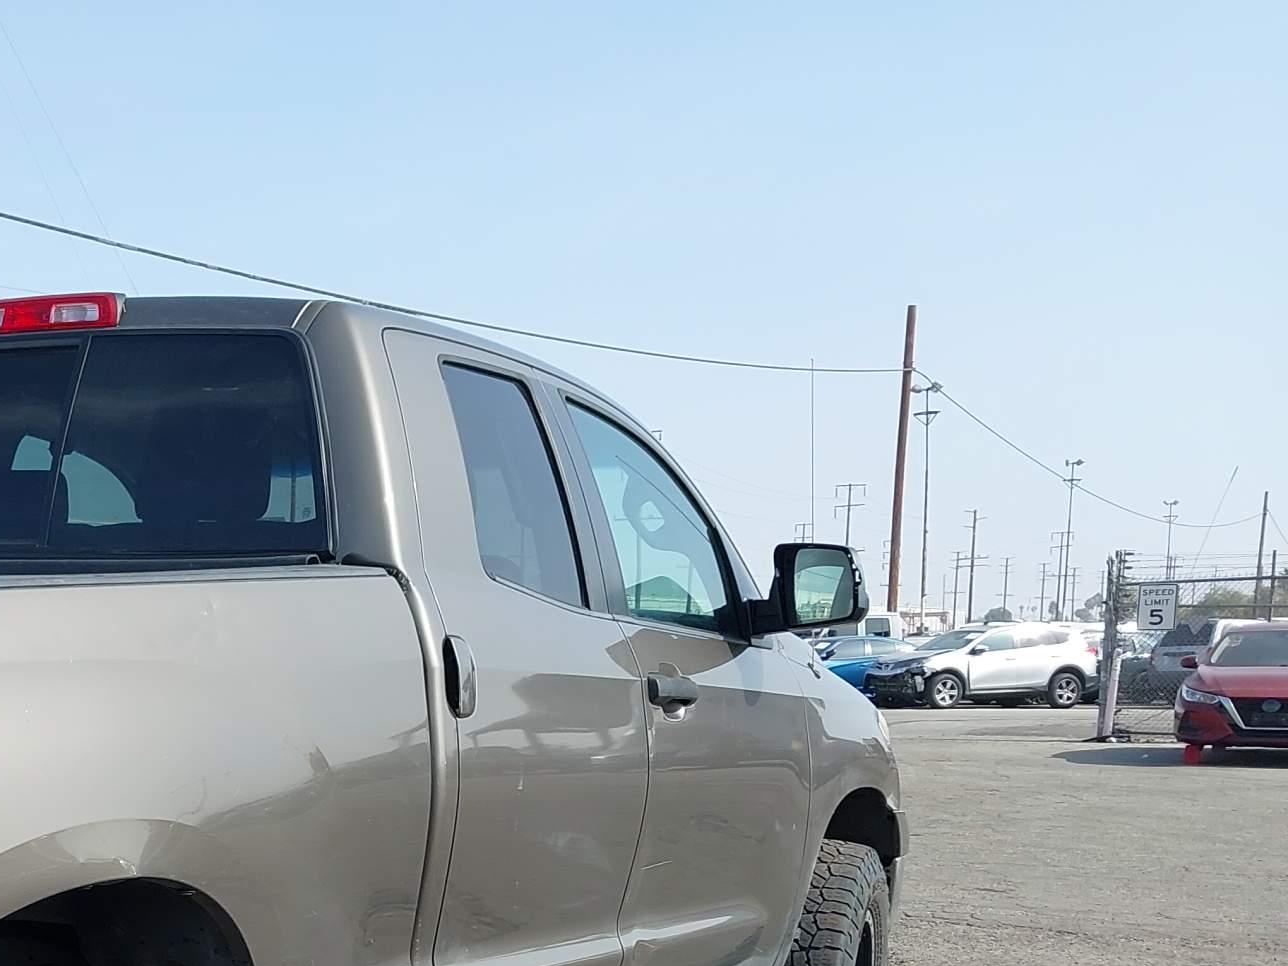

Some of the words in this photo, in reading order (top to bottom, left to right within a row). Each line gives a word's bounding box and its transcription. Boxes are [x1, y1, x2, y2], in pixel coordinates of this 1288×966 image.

[1142, 588, 1175, 596] SPEED
[1144, 598, 1171, 606] LIMIT
[1148, 608, 1164, 626] 5
